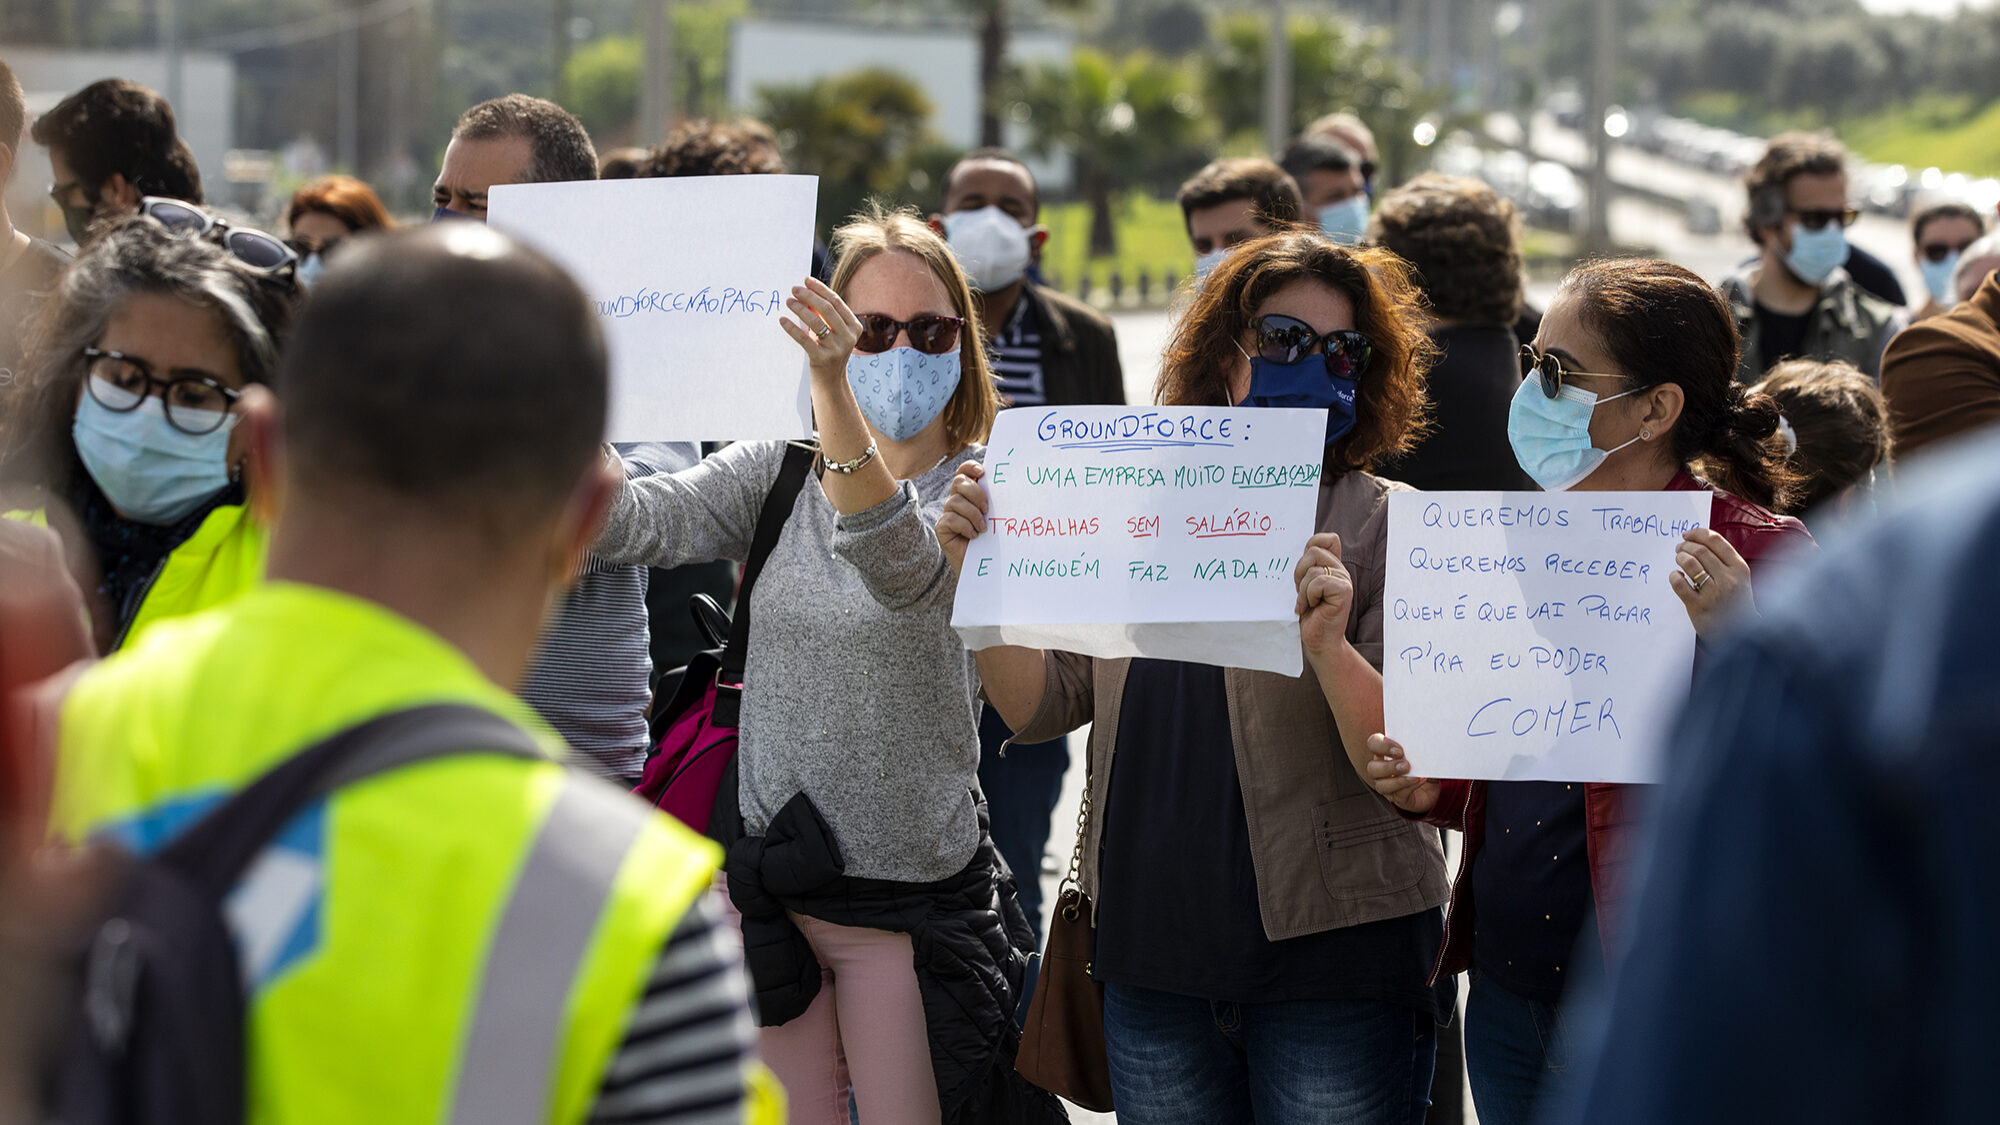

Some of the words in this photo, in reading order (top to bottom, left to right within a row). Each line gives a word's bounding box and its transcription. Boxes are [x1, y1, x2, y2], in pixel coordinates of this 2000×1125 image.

[994, 448, 1014, 484] É
[1027, 467, 1077, 488] UMA
[1086, 466, 1165, 487] EMPRESA
[1232, 463, 1321, 489] ENGRAÇADA
[989, 516, 1100, 537] TRABALHAS
[1127, 516, 1160, 538] SEM
[1423, 502, 1569, 528] QUEREMOS
[977, 558, 993, 578] E
[1129, 561, 1169, 582] FAZ
[1409, 547, 1527, 574] QUEREMOS
[1546, 553, 1651, 584] RECEBER
[1394, 598, 1443, 622] QUEM
[1453, 594, 1468, 621] É
[1477, 606, 1518, 623] QUE
[1526, 601, 1566, 620] VAI
[1577, 595, 1651, 625] PAGAR
[1400, 641, 1464, 674] P'RA
[1490, 653, 1521, 671] EU
[1529, 646, 1609, 677] PODER
[1467, 697, 1621, 740] COMER
